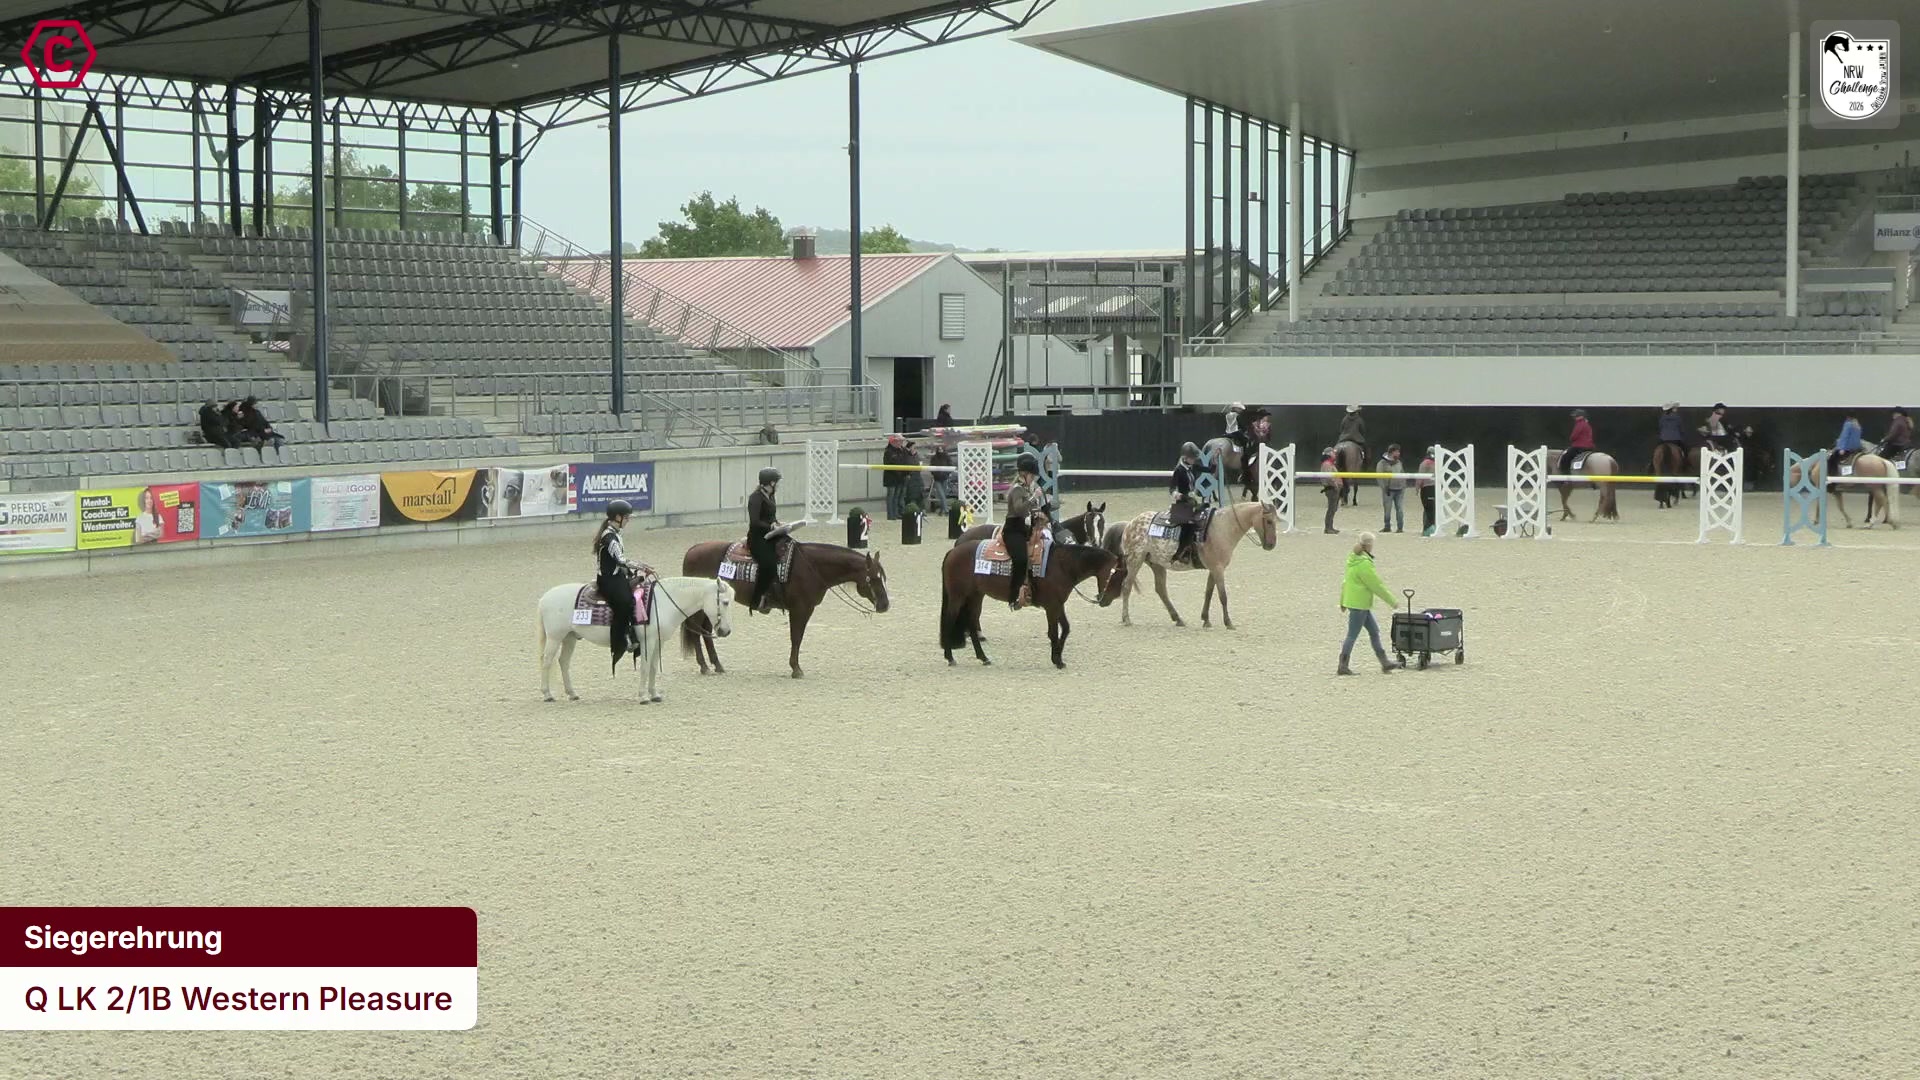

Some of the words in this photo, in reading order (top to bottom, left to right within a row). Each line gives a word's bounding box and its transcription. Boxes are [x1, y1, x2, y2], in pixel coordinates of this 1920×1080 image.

[1876, 227, 1912, 237] Allianz
[582, 474, 648, 495] AMERICANA
[82, 497, 111, 507] Mental-
[402, 489, 452, 507] marstall
[11, 502, 48, 513] PFERDE
[82, 509, 116, 519] Coaching
[117, 507, 128, 517] für
[11, 512, 68, 525] PROGRAMM
[82, 521, 134, 532] Westernreiter.
